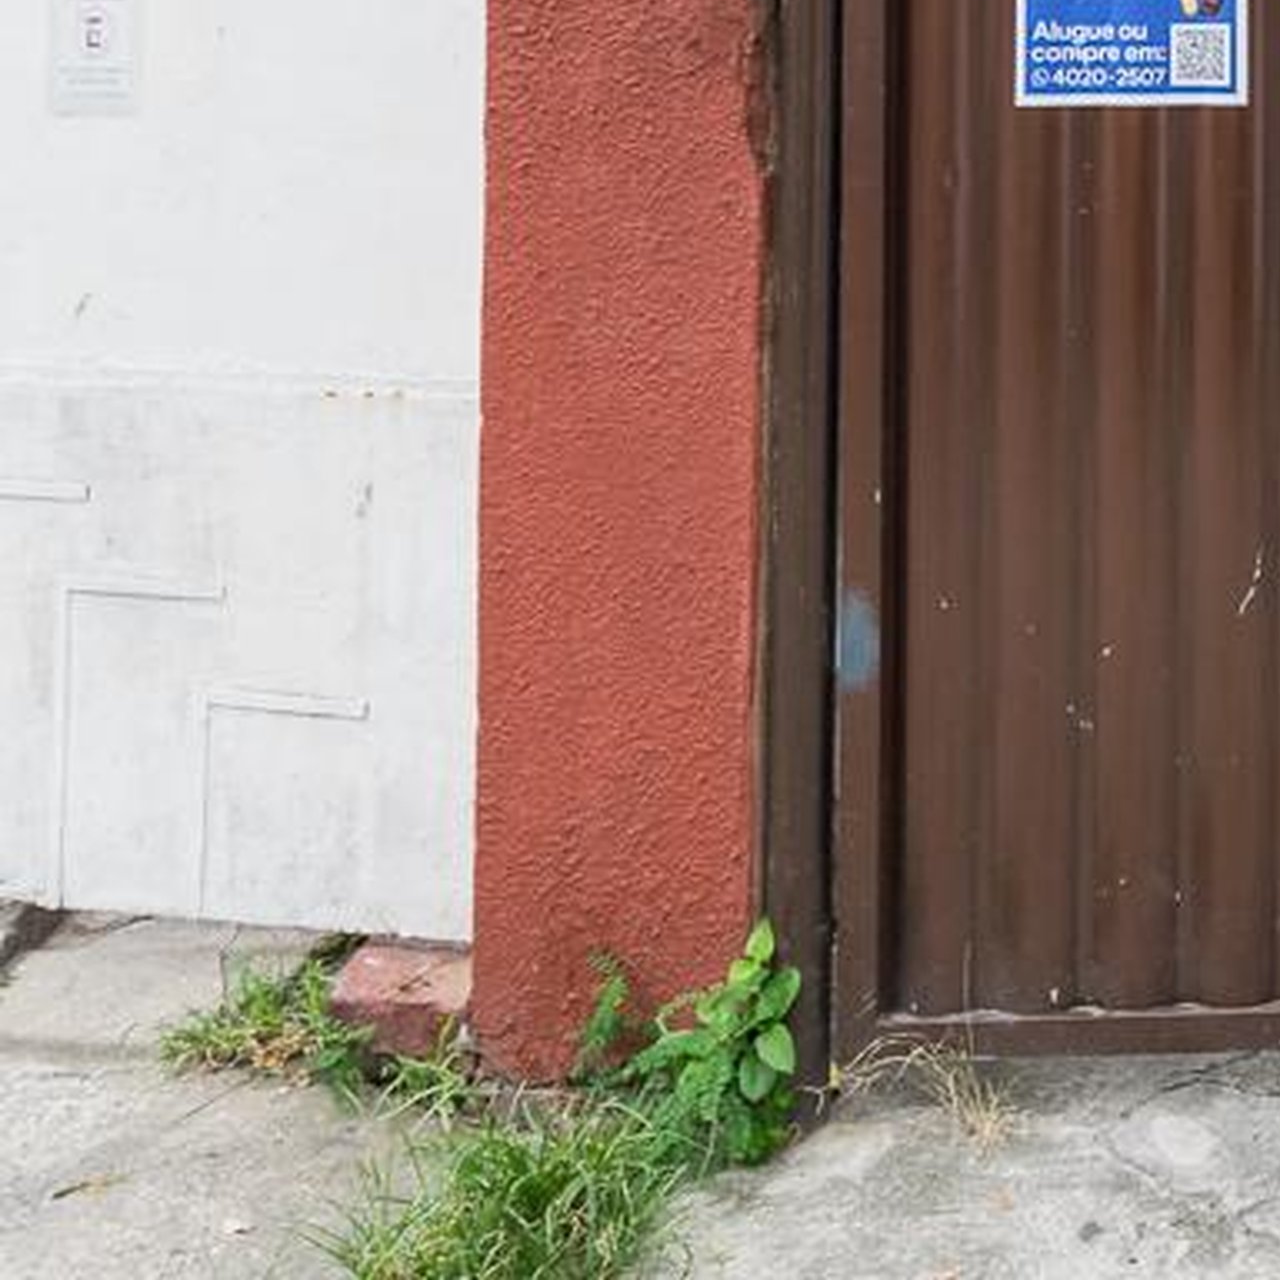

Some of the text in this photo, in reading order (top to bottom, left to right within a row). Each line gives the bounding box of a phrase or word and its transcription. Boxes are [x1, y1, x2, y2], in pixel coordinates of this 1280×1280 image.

[1033, 23, 1148, 44] Alugue ou
[1031, 46, 1119, 66] compre
[1052, 68, 1167, 87] 4020-2507
